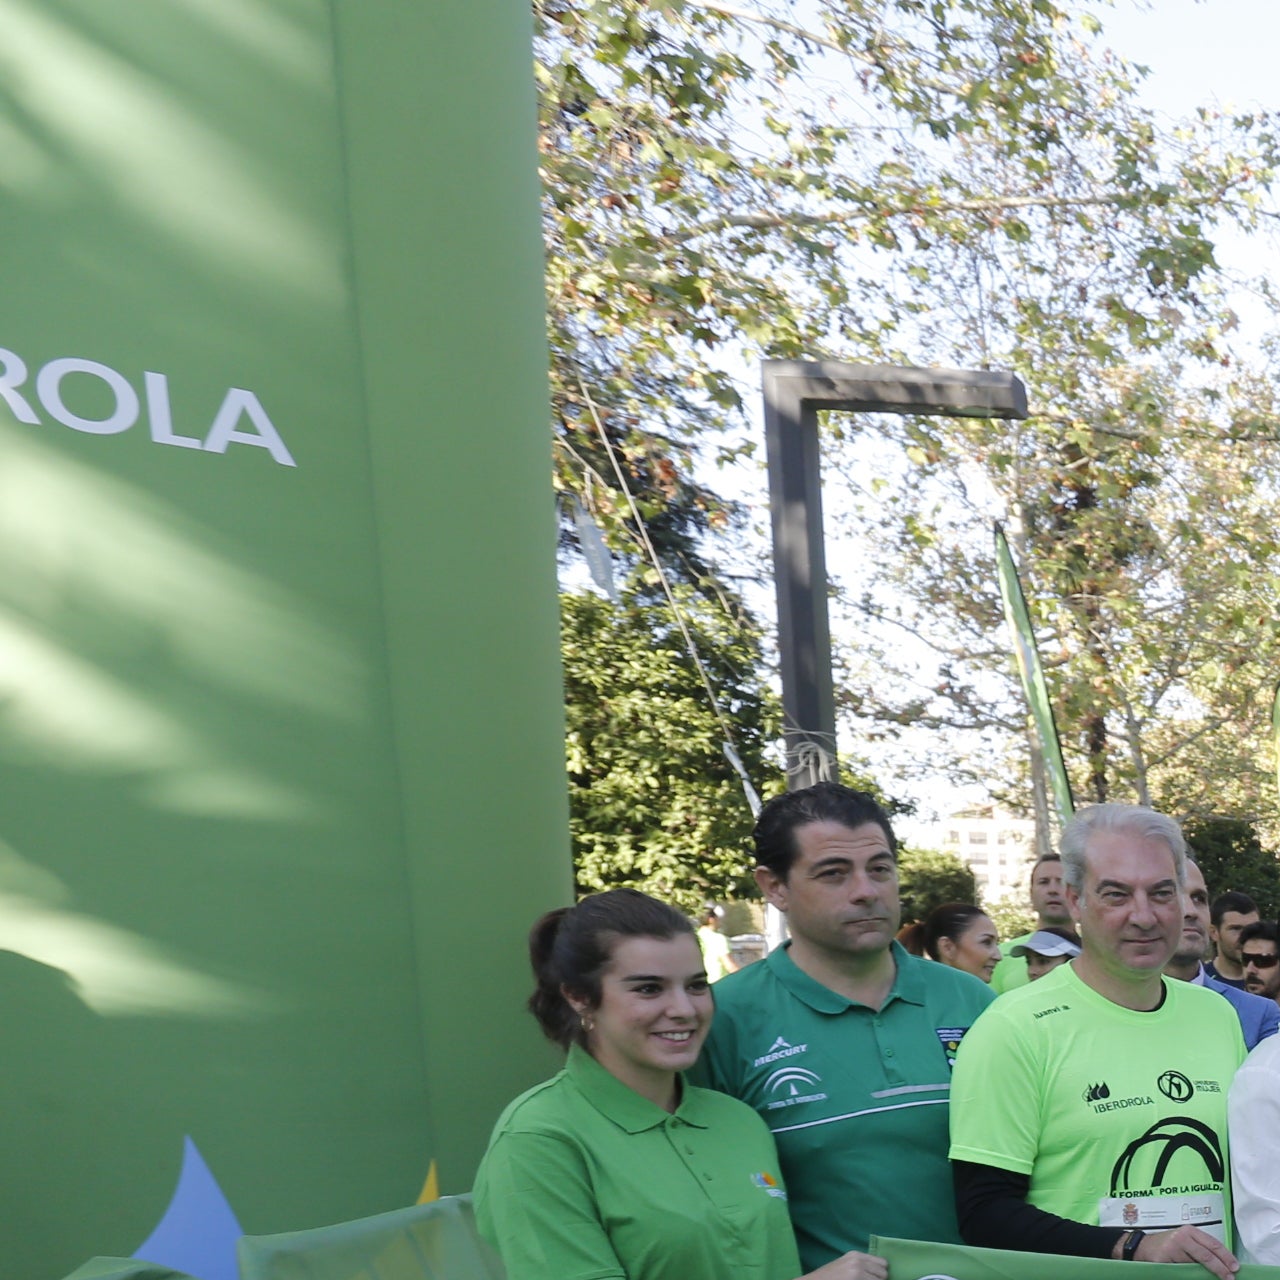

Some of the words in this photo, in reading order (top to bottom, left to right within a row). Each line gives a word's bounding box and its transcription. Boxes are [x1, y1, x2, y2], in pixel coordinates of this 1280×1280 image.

[754, 1044, 808, 1067] MERCURY
[1093, 1096, 1155, 1114] IBERDROLA
[1119, 1189, 1153, 1199] FORMA
[1160, 1187, 1178, 1195] POR
[1180, 1186, 1190, 1194] LA
